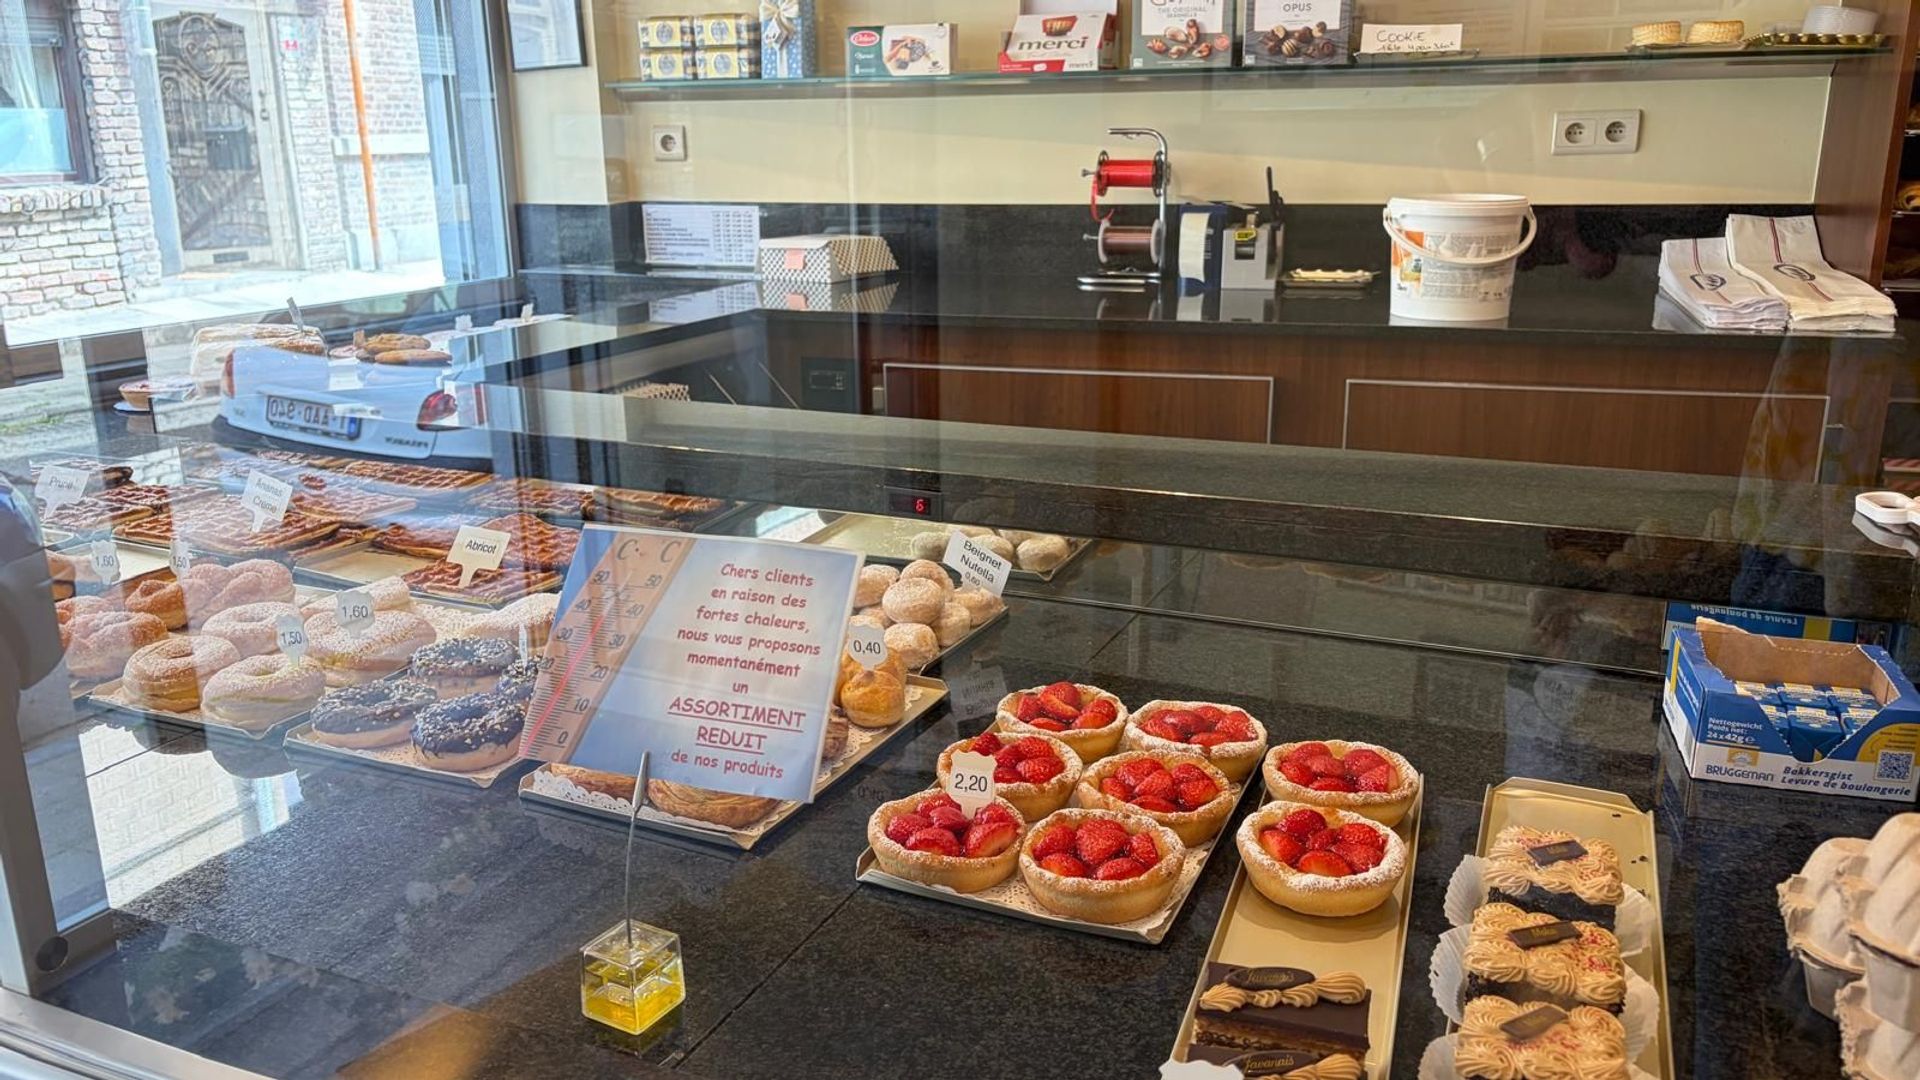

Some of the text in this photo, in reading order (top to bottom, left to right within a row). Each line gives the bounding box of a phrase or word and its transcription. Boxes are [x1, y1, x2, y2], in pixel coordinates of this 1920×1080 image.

[1282, 2, 1312, 13] OPUS
[1018, 36, 1089, 51] merci
[1376, 30, 1426, 43] COOKIE
[1069, 61, 1094, 69] merci
[915, 498, 925, 512] 6
[465, 539, 497, 555] Abricot
[963, 540, 1002, 570] Beignet
[720, 562, 816, 588] Chers clients
[960, 554, 995, 584] Nutella
[711, 587, 807, 609] en raison des
[341, 604, 369, 619] 1,60
[696, 605, 810, 634] fortes chaleurs,
[280, 630, 303, 647] 1,50
[608, 633, 626, 647] 30
[677, 628, 822, 656] nous vous proposons
[853, 639, 881, 655] 0,40
[590, 664, 609, 680] 20
[687, 652, 801, 678] momentanément
[732, 682, 749, 695] un
[573, 697, 590, 712] 10
[669, 696, 807, 729] ASSORTIMENT
[1708, 717, 1763, 731] Nettogewicht
[557, 730, 569, 745] 0
[697, 725, 768, 751] REDUIT
[671, 748, 784, 779] de nos produits
[1705, 764, 1774, 782] BRUGGEMAN
[1783, 765, 1853, 781] Bakkersgist
[954, 772, 988, 793] 2,20
[1780, 776, 1912, 796] Levure de boulangerie
